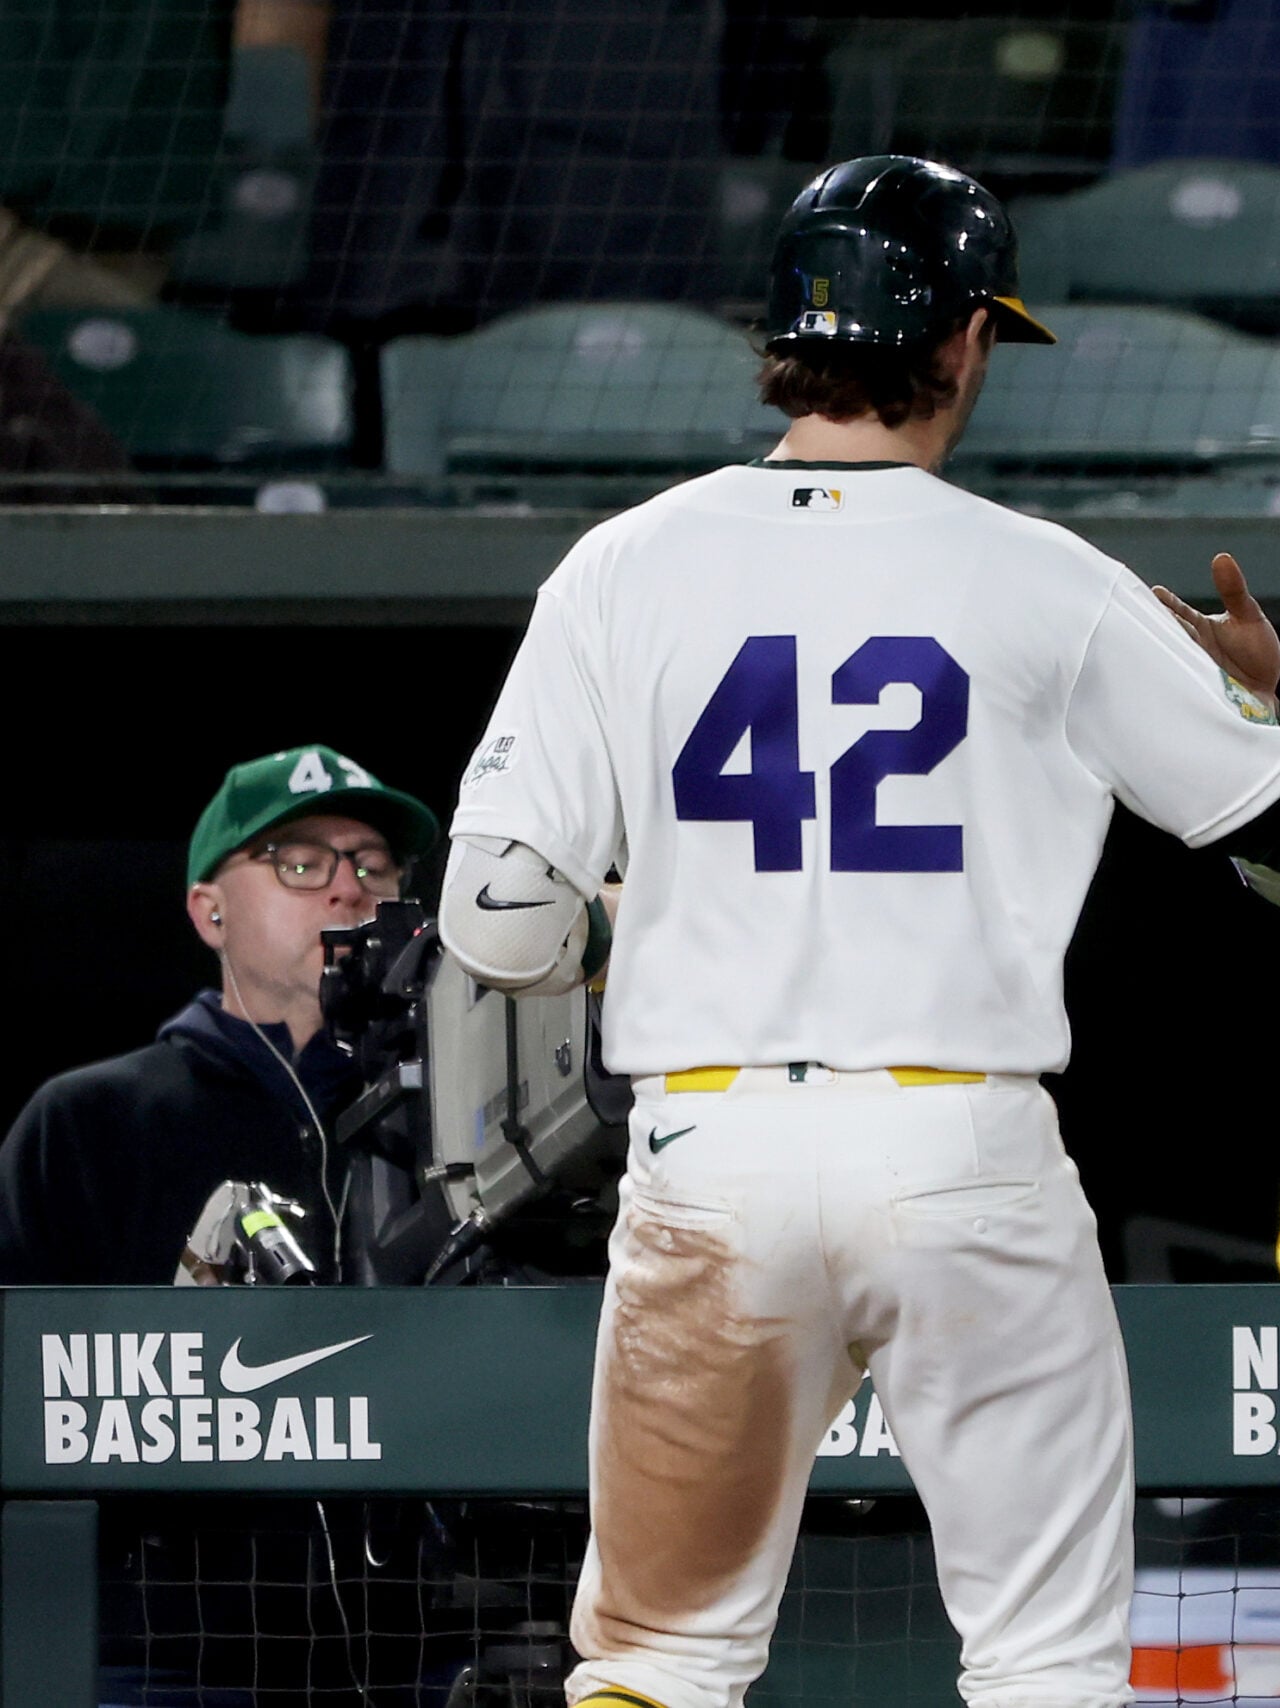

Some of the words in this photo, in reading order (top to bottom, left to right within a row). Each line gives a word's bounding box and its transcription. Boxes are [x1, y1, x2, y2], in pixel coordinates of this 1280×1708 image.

[812, 279, 829, 307] 5
[672, 635, 970, 872] 42
[42, 1332, 205, 1397] NIKE
[44, 1396, 382, 1464] BASEBALL
